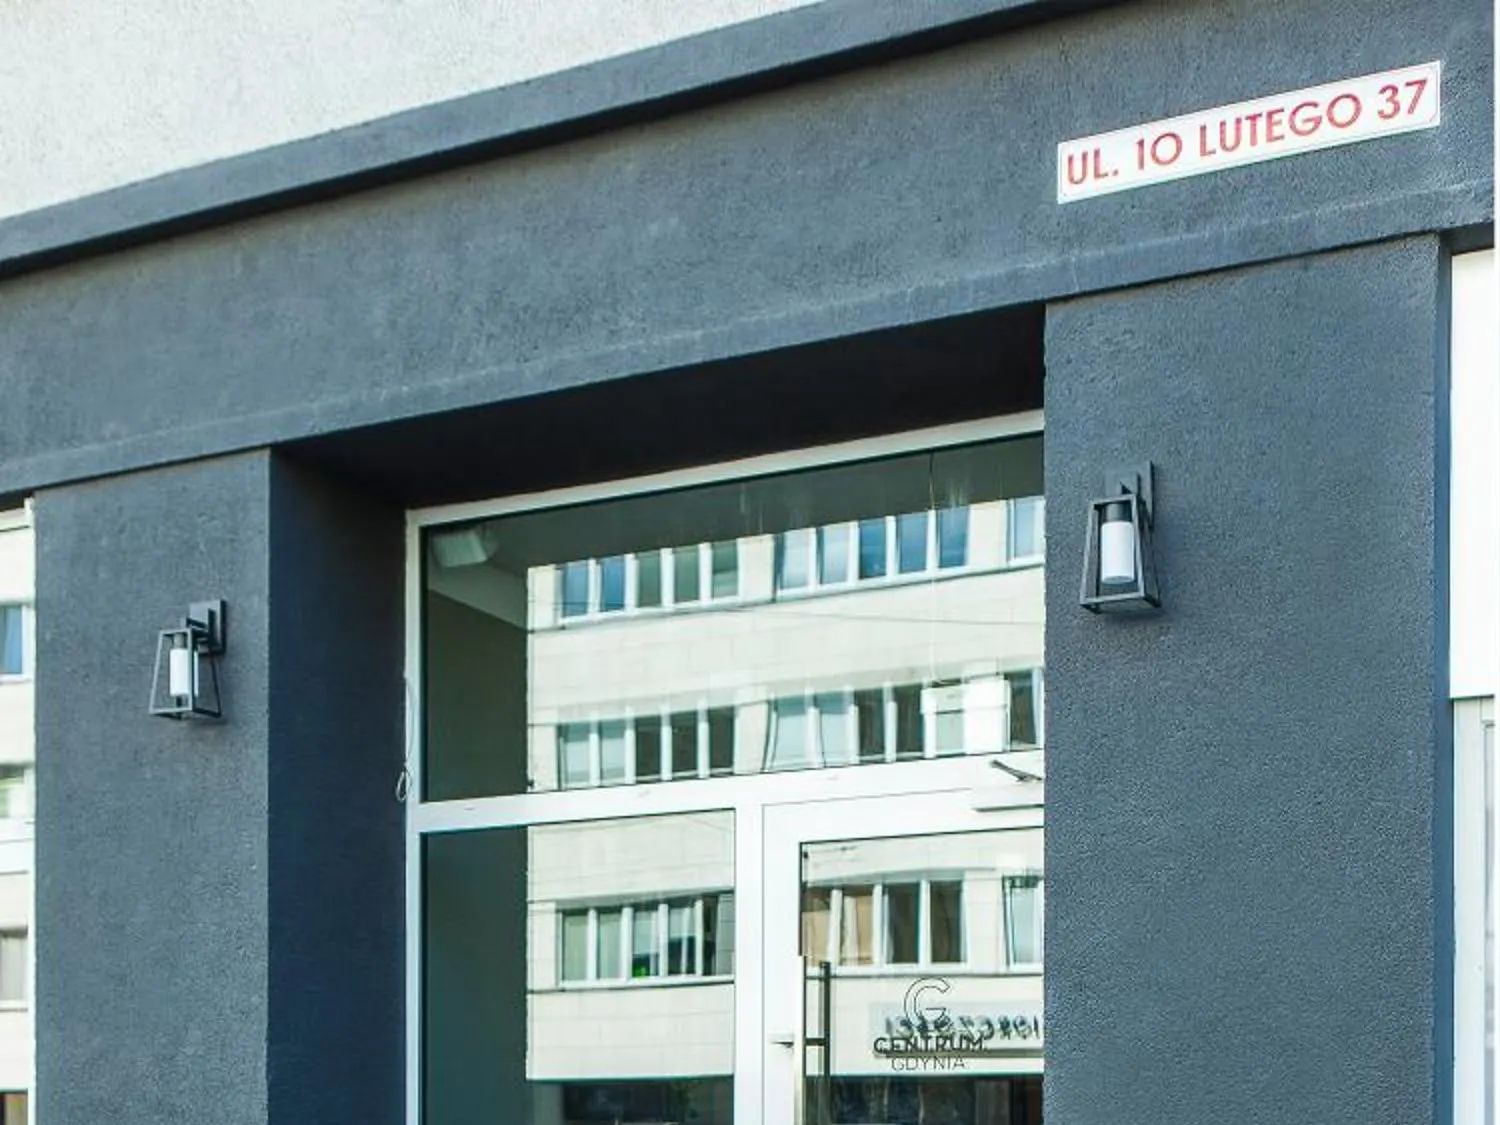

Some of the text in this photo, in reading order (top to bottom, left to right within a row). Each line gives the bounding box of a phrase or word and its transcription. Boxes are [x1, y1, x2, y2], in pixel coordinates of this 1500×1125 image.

[1067, 78, 1429, 185] UL. 10 LUTEGO 37
[873, 1033, 985, 1055] CENTRUM
[891, 1055, 968, 1072] GDYNIA
